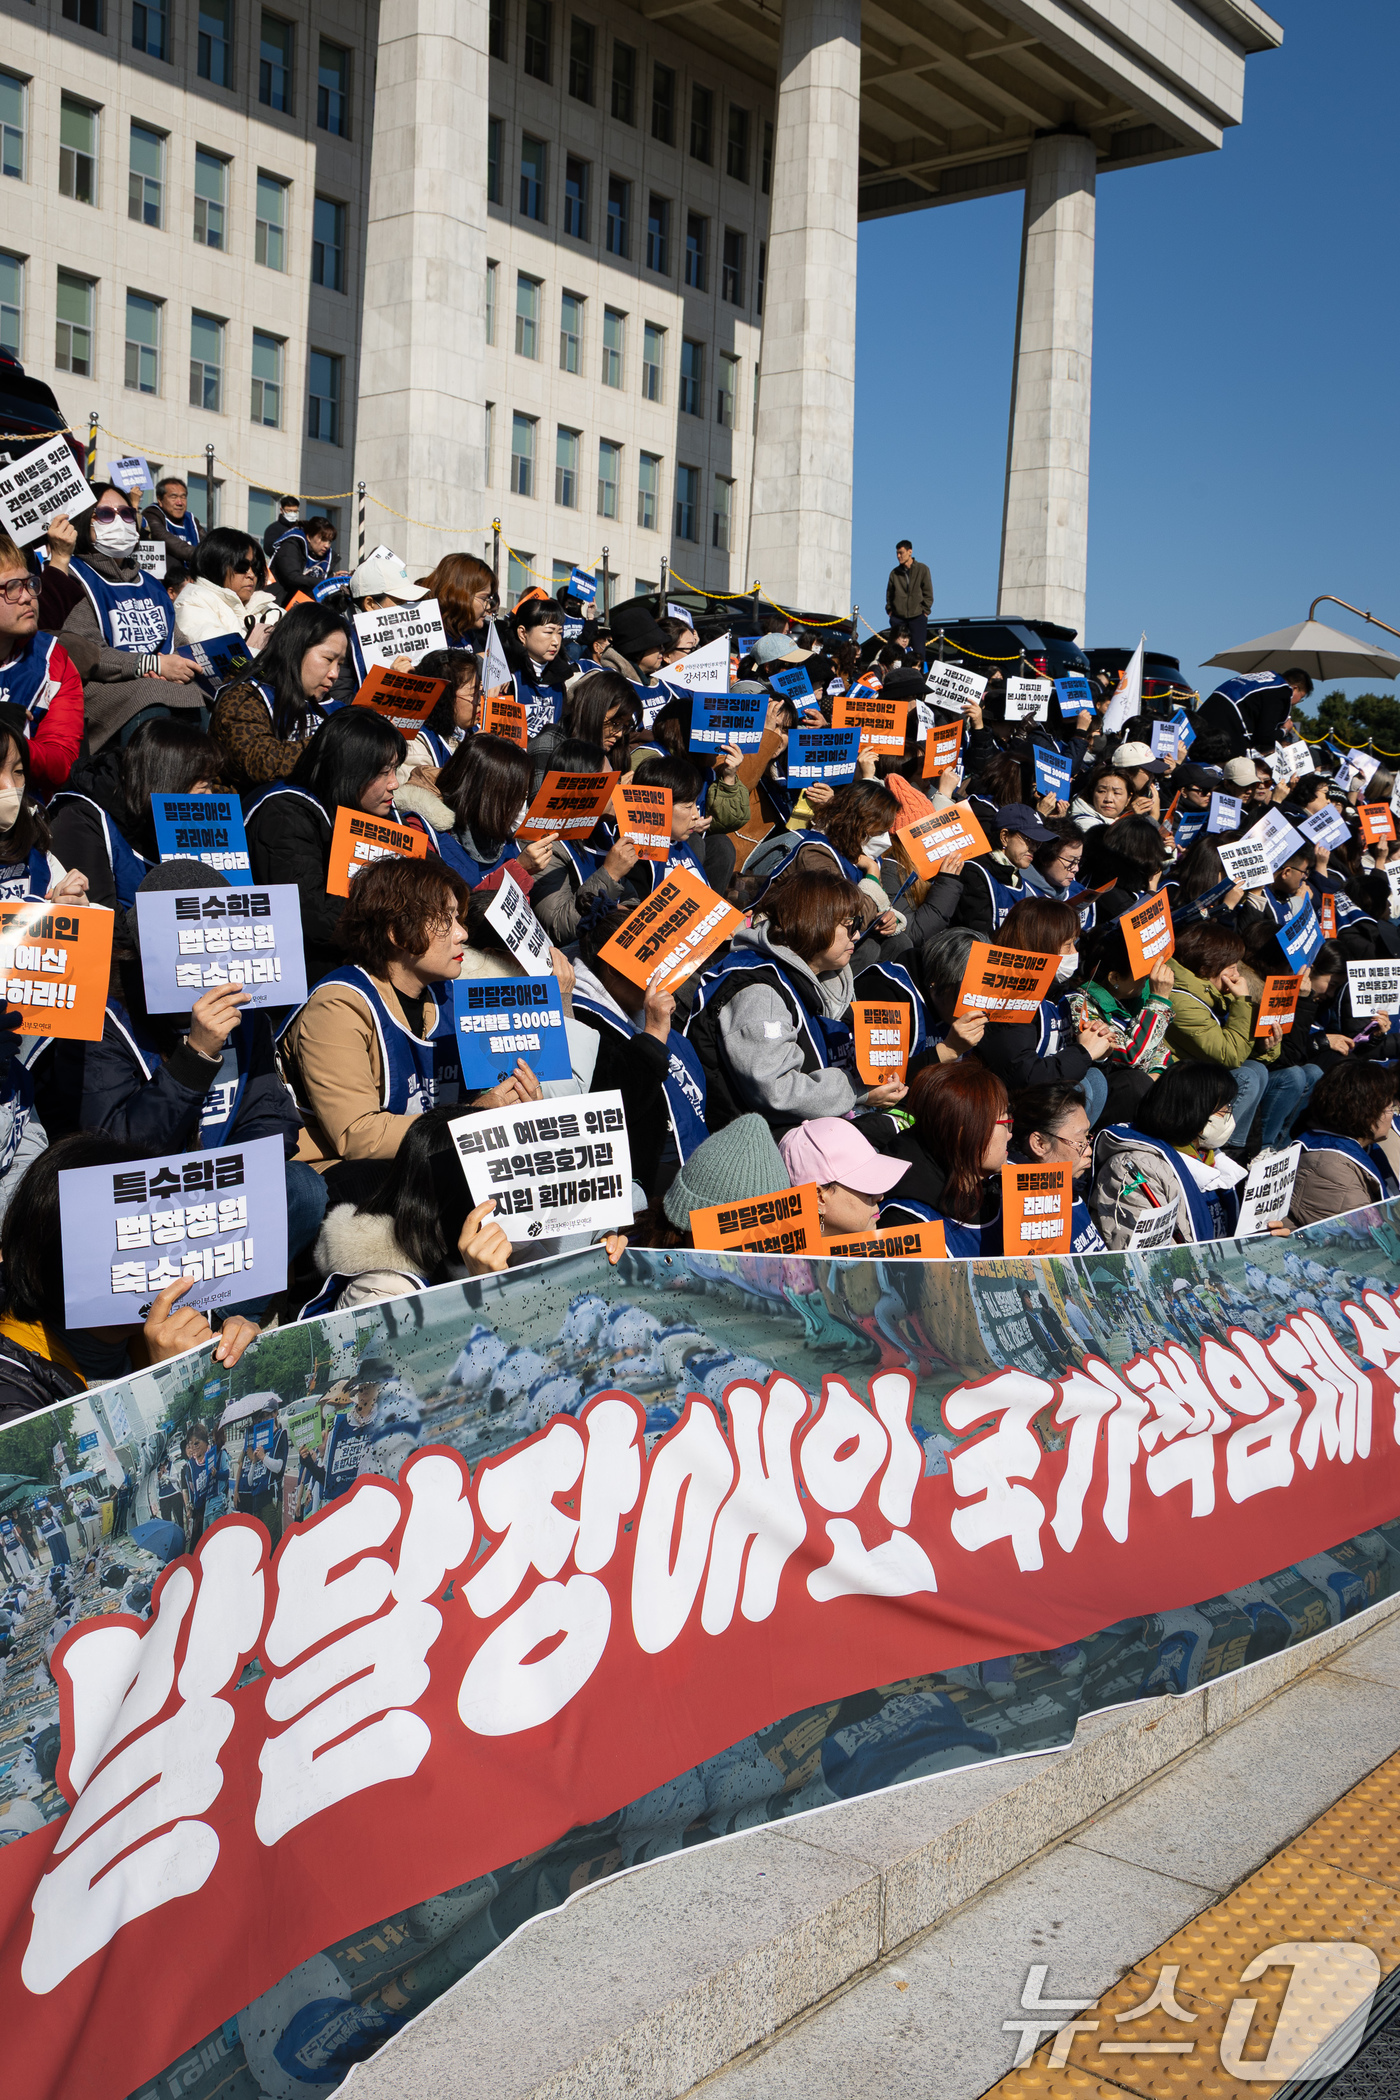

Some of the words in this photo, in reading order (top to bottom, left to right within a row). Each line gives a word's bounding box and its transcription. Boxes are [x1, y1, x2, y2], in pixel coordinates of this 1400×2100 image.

[0, 479, 14, 497] 대
[14, 458, 49, 487] 예방을
[47, 444, 71, 466] 위한
[5, 465, 73, 513] 권익옹호기관
[10, 508, 39, 531] 지원
[38, 479, 85, 515] 확대하라!
[376, 609, 420, 627] 자립지원
[360, 630, 394, 646] 본사업
[396, 620, 443, 640] 1,000명
[381, 638, 430, 658] 실시하라!
[380, 672, 436, 694] 발달장애인
[684, 670, 718, 684] 강서지회
[490, 702, 522, 720] 발달장애인
[704, 698, 760, 711] 발달장애인
[846, 701, 896, 714] 발달장애인
[708, 714, 754, 728] 권리예산
[845, 716, 894, 729] 국가책임제
[691, 729, 726, 743] 국회는
[799, 733, 853, 746] 발달장애인
[805, 750, 847, 763] 권리예산
[789, 766, 822, 777] 국회는
[555, 776, 608, 790] 발달장애인
[546, 796, 599, 810] 국가책임제
[622, 788, 665, 806] 발달장애인
[164, 802, 232, 822] 발달장애인
[627, 810, 665, 827] 국가책임제
[350, 818, 414, 852] 발달장애인
[909, 809, 960, 839] 발달장애인
[175, 828, 229, 848] 권리예산
[175, 893, 271, 921] 특수학급
[615, 882, 682, 950] 발달장애인
[1131, 898, 1164, 930] 발달장애인
[634, 897, 700, 963] 국가책임제
[685, 900, 732, 947] 보장하라
[177, 925, 275, 956] 법정정원
[986, 949, 1048, 971] 발달장애인
[176, 957, 282, 989] 축소하라!
[981, 972, 1039, 992] 국가책임제
[0, 979, 76, 1009] 하라!!
[468, 983, 549, 1009] 발달장애인
[460, 1013, 510, 1034] 주간활동
[513, 1010, 561, 1030] 3000명
[864, 1009, 902, 1025] 발달장애인
[489, 1034, 541, 1054] 확대하라
[456, 1125, 510, 1156] 학대
[513, 1113, 580, 1144] 예방을
[584, 1108, 624, 1135] 위한
[486, 1142, 614, 1183] 권익옹호기관
[113, 1154, 244, 1204] 특수학급
[1017, 1173, 1064, 1191] 발달장애인
[488, 1187, 535, 1218] 지원
[538, 1174, 623, 1210] 확대하라!
[1023, 1196, 1061, 1215] 권리예산
[115, 1195, 248, 1251] 법정정원
[717, 1193, 803, 1235] 발달장애인
[111, 1238, 254, 1294] 축소하라!
[21, 1374, 938, 1995] 발달장애인
[943, 1309, 1374, 1572] 국가책임제
